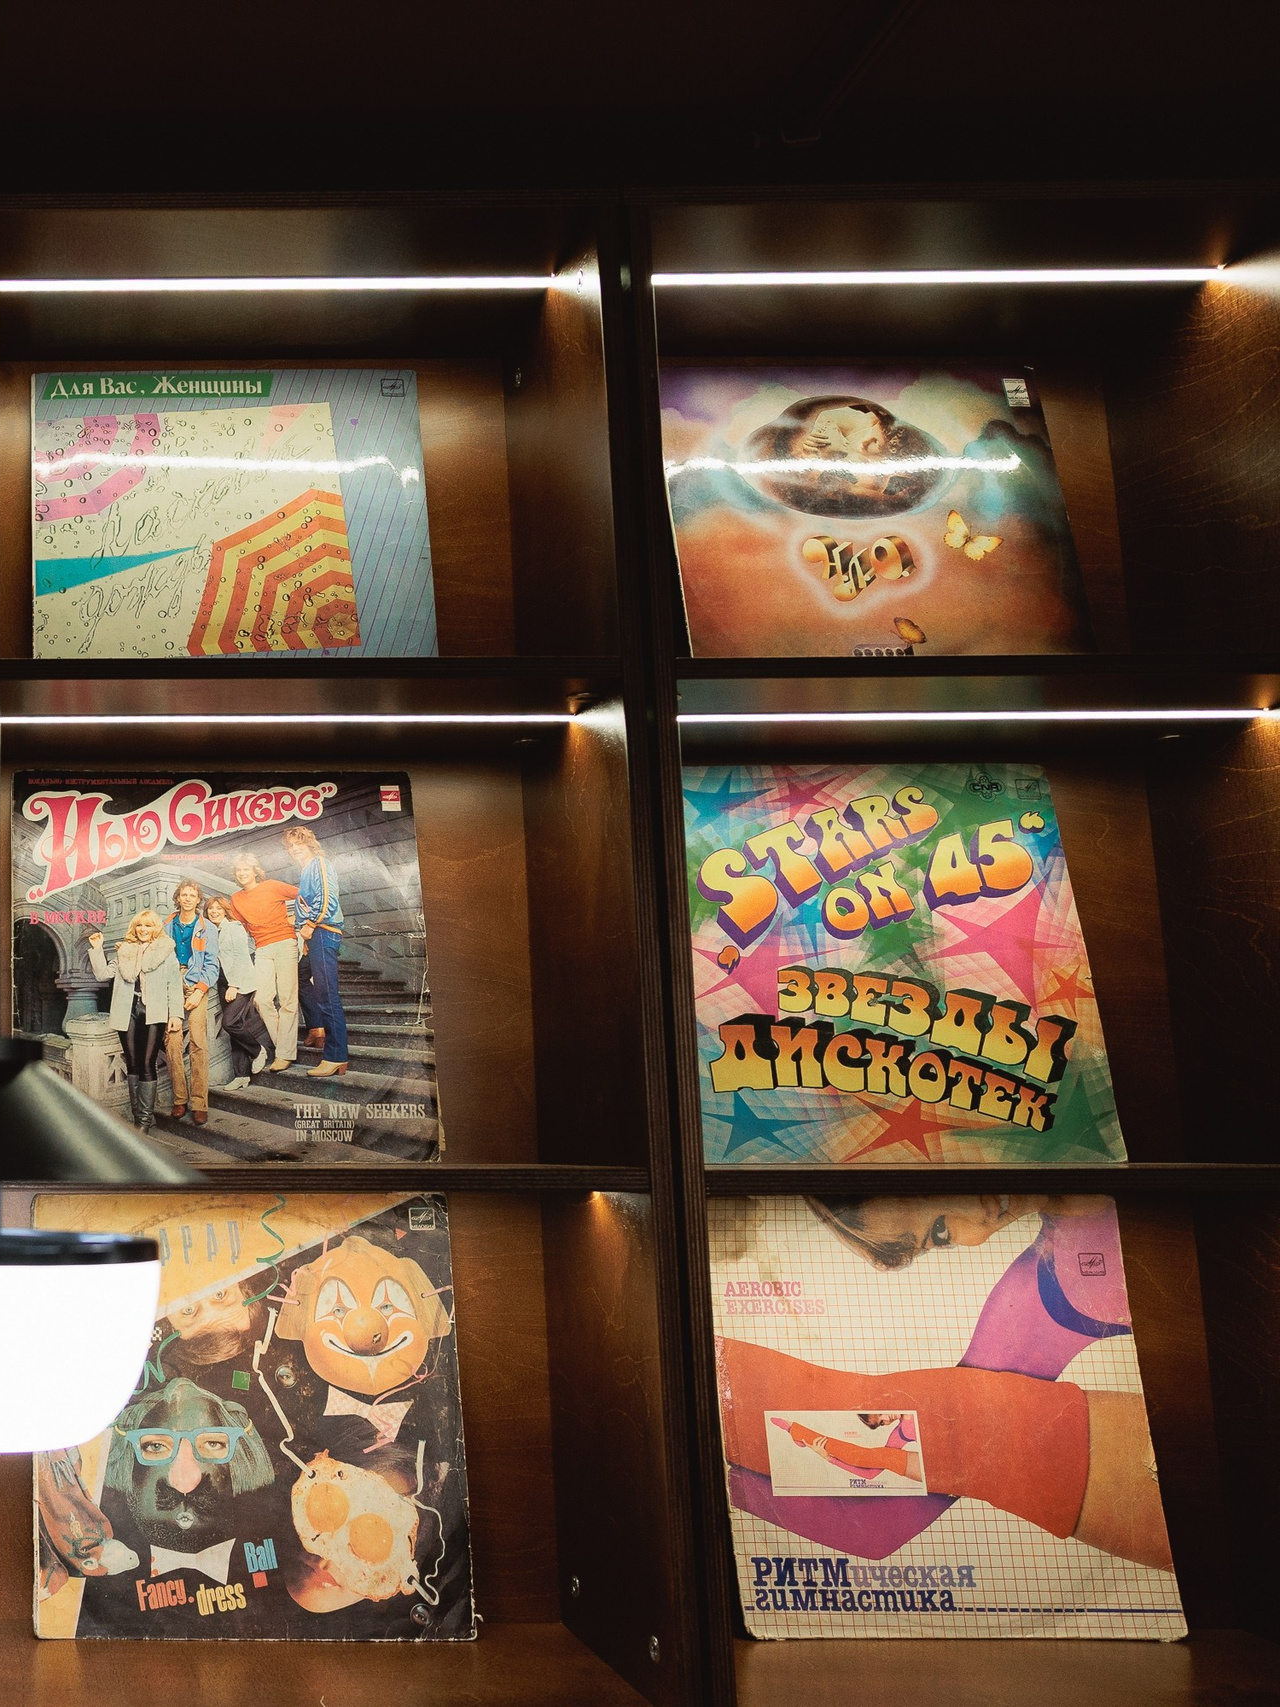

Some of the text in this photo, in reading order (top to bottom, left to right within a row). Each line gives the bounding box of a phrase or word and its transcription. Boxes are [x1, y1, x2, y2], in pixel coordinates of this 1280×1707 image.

[50, 377, 94, 399] Для
[152, 376, 263, 397] Женщины
[822, 861, 916, 941] ON
[30, 910, 107, 925] В МОСКВЕ
[777, 966, 1078, 1084] ЗВЕЗДЫ
[709, 1013, 1058, 1134] ДИСКОТЕК
[293, 1103, 426, 1119] THE NEW SEEKERS
[294, 1119, 355, 1129] (GREAT BRITAIN)
[295, 1129, 354, 1142] IN MOSCOW
[724, 1281, 802, 1298] AEROBIC
[726, 1298, 826, 1315] EXERCISES
[243, 1538, 279, 1573] Ball
[750, 1557, 977, 1588] РИТМическая
[196, 1582, 248, 1616] dress
[754, 1588, 958, 1613] гимнастика
